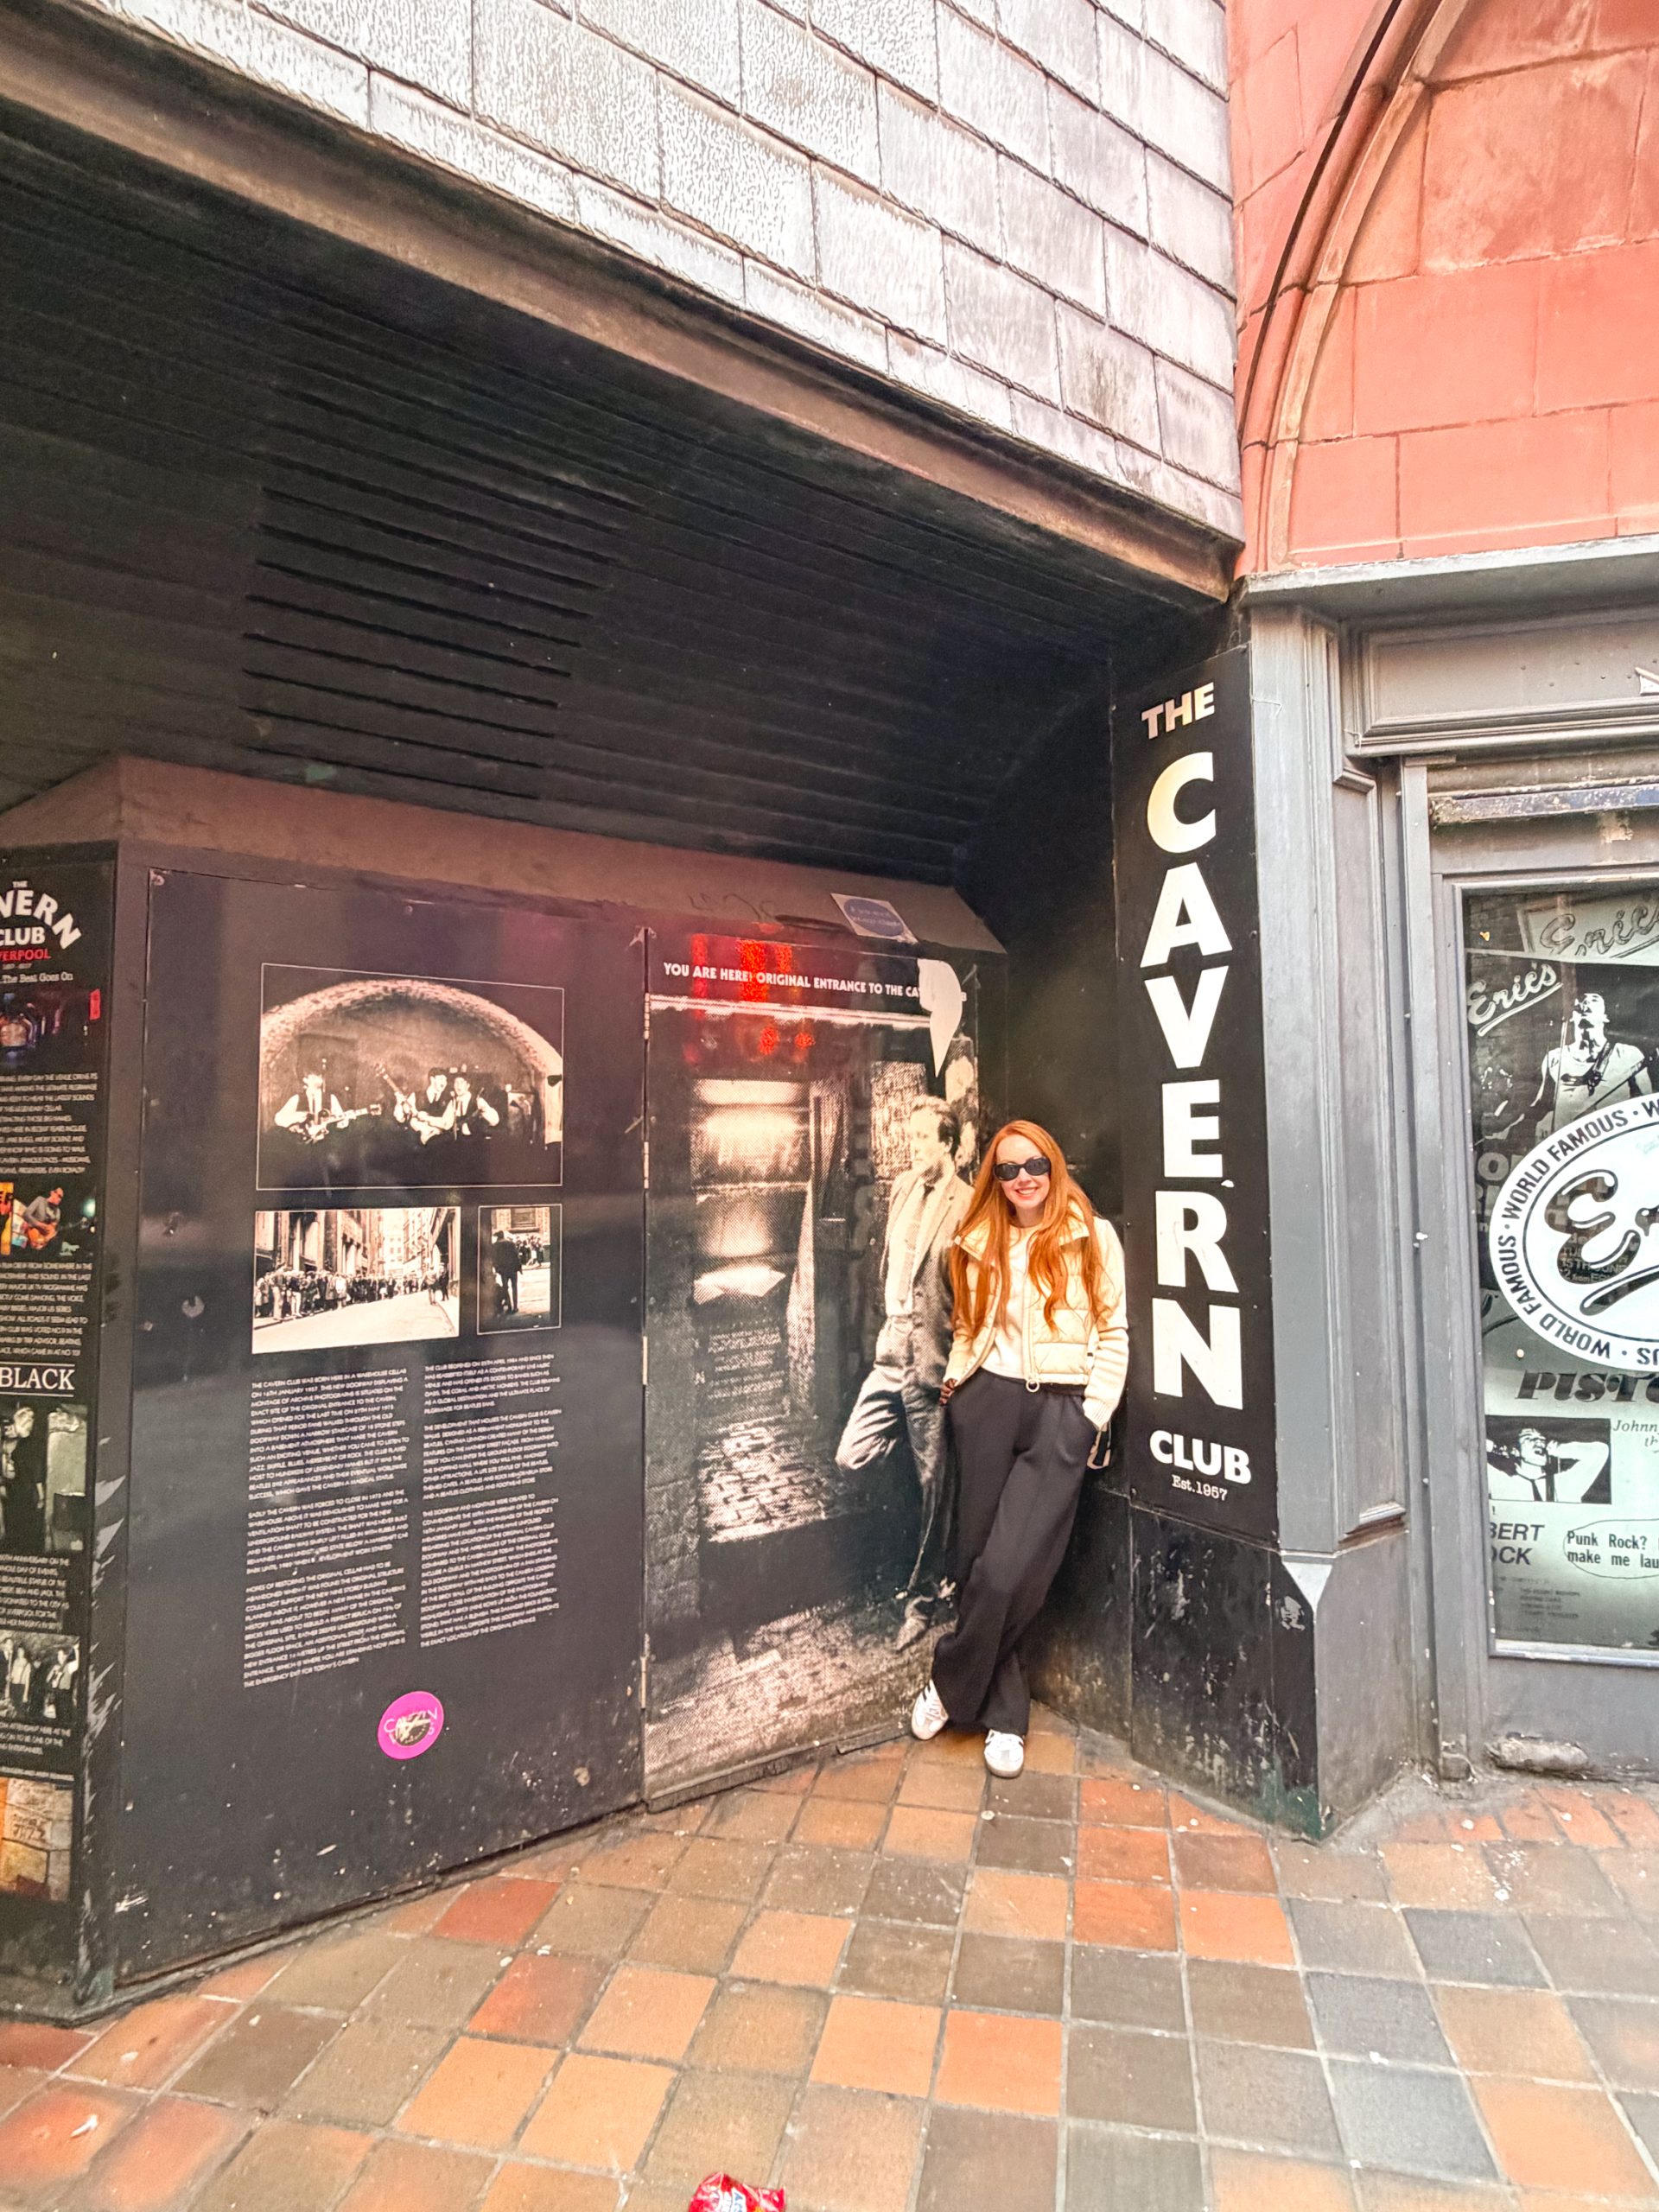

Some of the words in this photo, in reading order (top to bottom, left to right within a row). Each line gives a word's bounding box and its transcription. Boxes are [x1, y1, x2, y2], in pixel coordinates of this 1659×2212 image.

[1141, 682, 1215, 740] THE
[0, 949, 51, 962] ERPOOL
[664, 962, 690, 976] YOU
[693, 965, 717, 980] ARE
[756, 972, 811, 988] ORIGINAL
[813, 977, 866, 993] ENTRANCE
[869, 982, 882, 995] TO
[885, 984, 903, 996] THE
[906, 986, 919, 998] CA
[1140, 752, 1243, 1410] CAVERN
[1547, 1109, 1629, 1162] FAMOUS
[1502, 1159, 1551, 1220] WORLD
[1497, 1235, 1542, 1315] FAMOUS
[1539, 1313, 1611, 1359] WORLD
[0, 1367, 75, 1389] BLACK
[1613, 1420, 1659, 1433] Johnn
[1150, 1430, 1251, 1484] CLUB
[1172, 1474, 1228, 1501] Est.1957
[1567, 1530, 1599, 1546] Punk
[1609, 1534, 1648, 1550] Rock?
[1567, 1551, 1601, 1563] make
[1611, 1557, 1630, 1566] me
